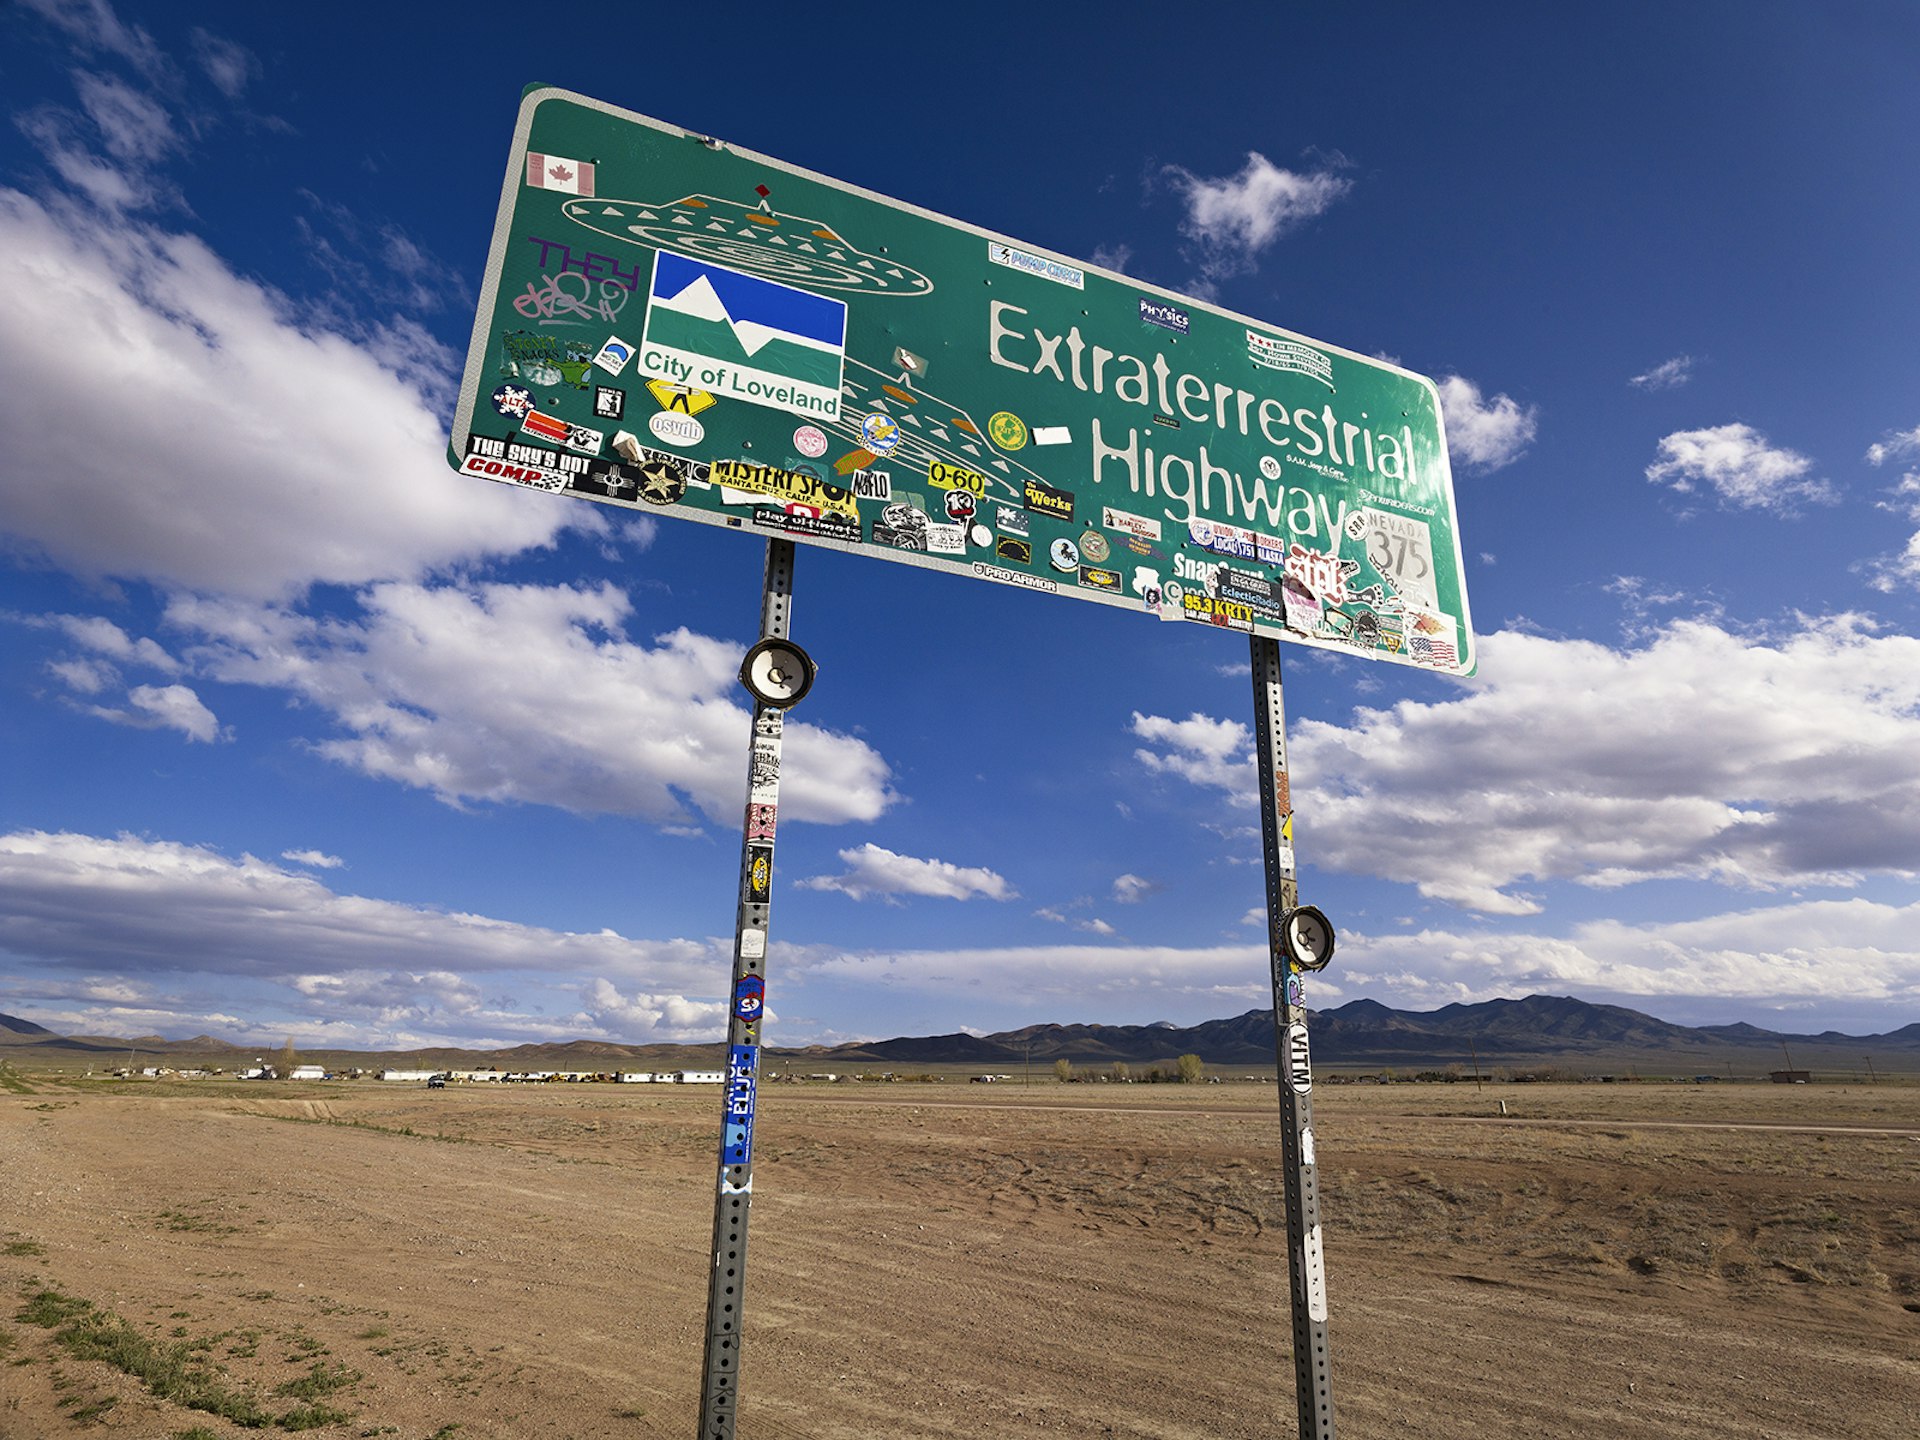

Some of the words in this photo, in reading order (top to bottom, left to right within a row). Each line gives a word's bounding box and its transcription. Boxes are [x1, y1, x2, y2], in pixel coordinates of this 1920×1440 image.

[527, 236, 640, 292] THEY
[643, 351, 693, 383] City
[700, 367, 726, 387] of
[732, 372, 839, 417] Loveland
[989, 299, 1418, 486] Extraterrestrial
[500, 394, 528, 409] ALTA
[650, 417, 701, 440] osvdb
[472, 436, 505, 455] THE
[508, 444, 556, 467] SKY'S
[559, 454, 592, 475] NOT
[466, 457, 542, 482] COMP
[720, 476, 752, 489] SANTA
[1092, 417, 1346, 556] Highway
[756, 510, 788, 525] play
[791, 514, 862, 536] ultimate
[1368, 512, 1426, 538] NEVADA
[1370, 531, 1429, 579] 375
[985, 566, 1011, 582] PRO
[1011, 573, 1058, 592] ARMOR
[1183, 595, 1213, 613] 95.3
[1213, 599, 1254, 622] KRTY
[1221, 586, 1281, 610] EclecticRadio
[733, 1065, 751, 1115] BLUE
